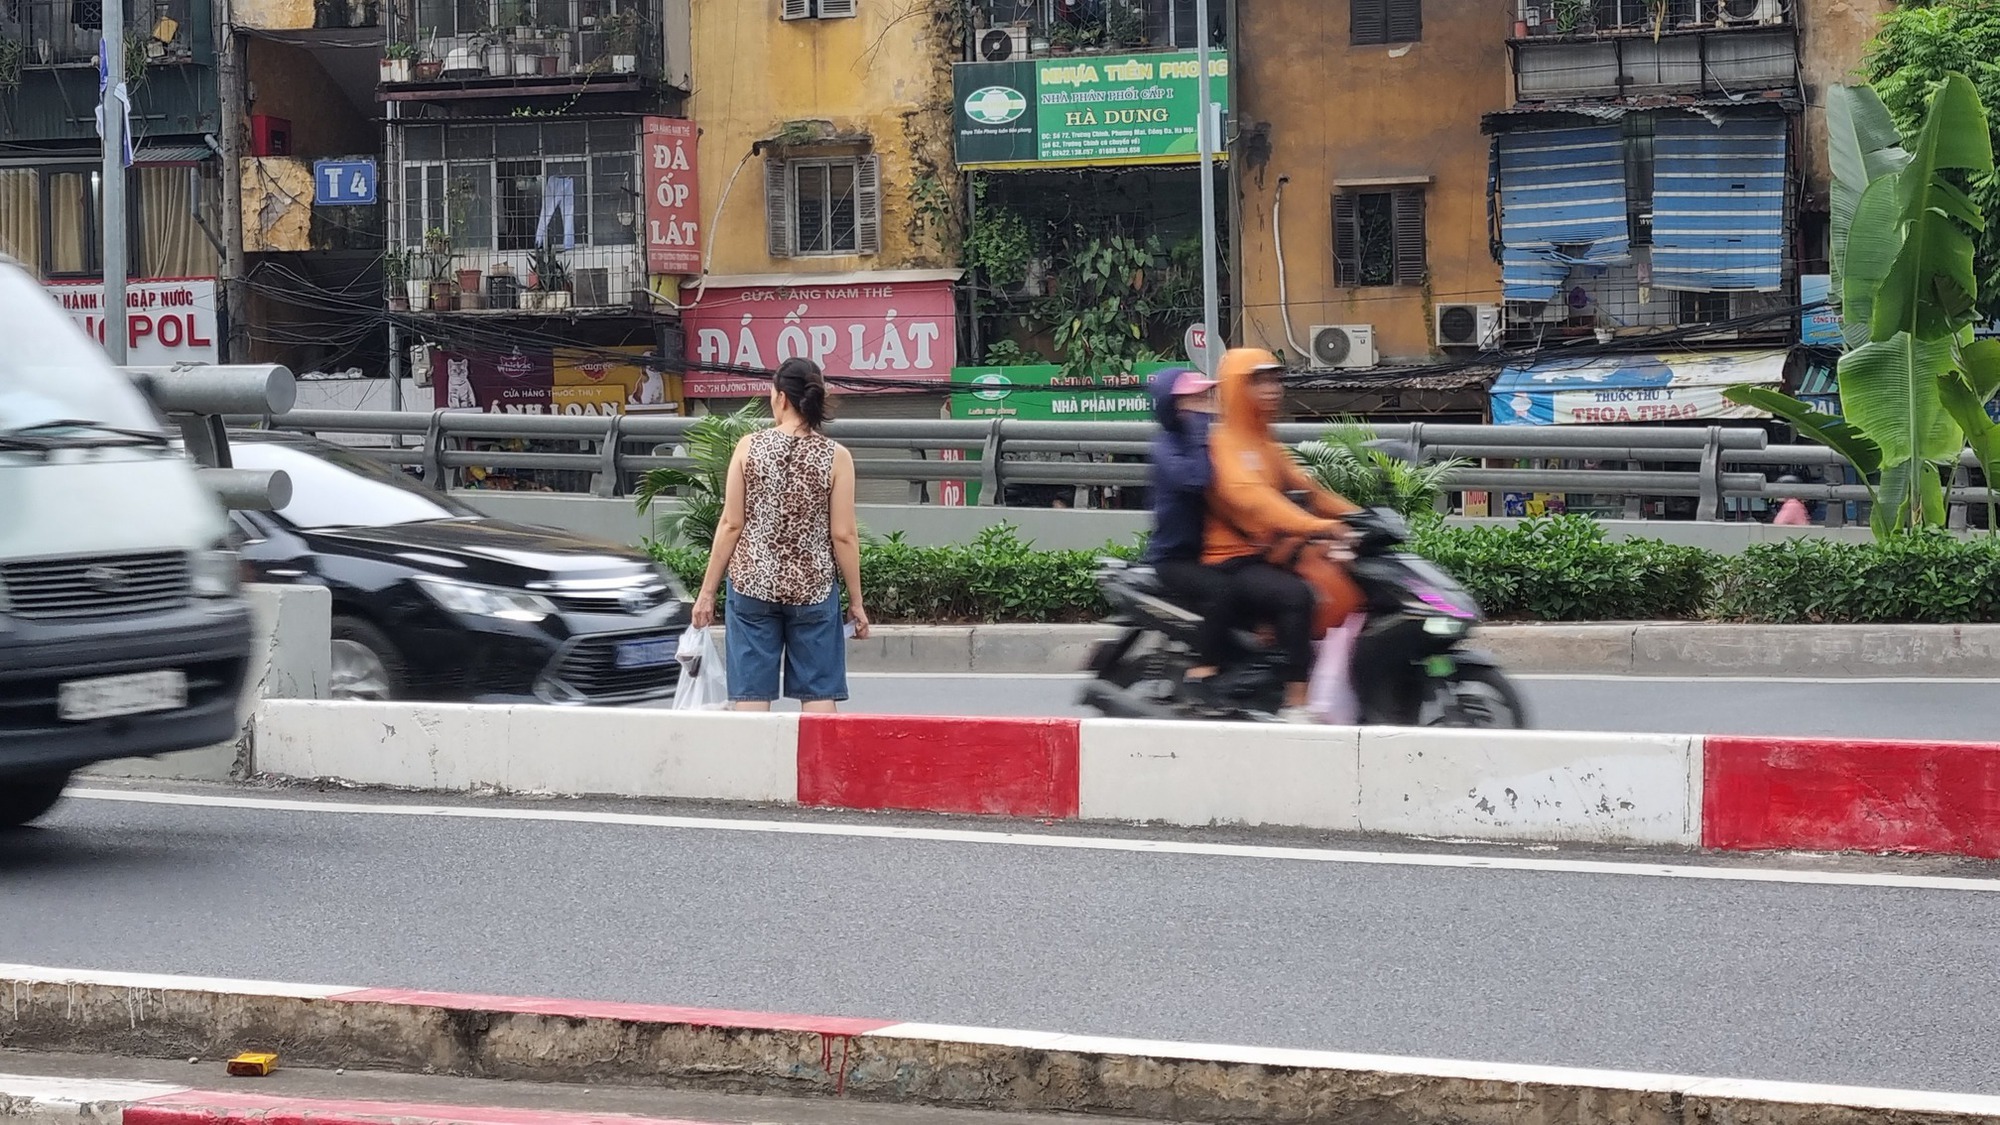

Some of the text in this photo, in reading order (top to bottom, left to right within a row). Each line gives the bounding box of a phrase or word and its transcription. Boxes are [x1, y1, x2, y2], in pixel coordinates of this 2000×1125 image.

[1041, 63, 1099, 87] NHỰA
[1041, 90, 1069, 105] NHÀ
[1070, 89, 1106, 104] PHÂN
[1108, 86, 1138, 101] PHỐI
[1141, 85, 1165, 100] CẤP
[1065, 107, 1169, 126] HÀ DUNG
[653, 139, 690, 171] ĐÁ
[324, 168, 367, 198] T 4
[657, 172, 689, 208] ỐP
[650, 214, 698, 246] LÁT
[160, 286, 193, 306] NƯỚC
[826, 288, 859, 299] NAM
[863, 285, 893, 298] THẾ
[697, 303, 939, 373] ĐÁ ỐP LÁT
[503, 387, 520, 398] CỬA
[1052, 396, 1079, 413] NHÀ
[1081, 396, 1116, 413] PHÂN
[1117, 393, 1151, 412] PHỐI:
